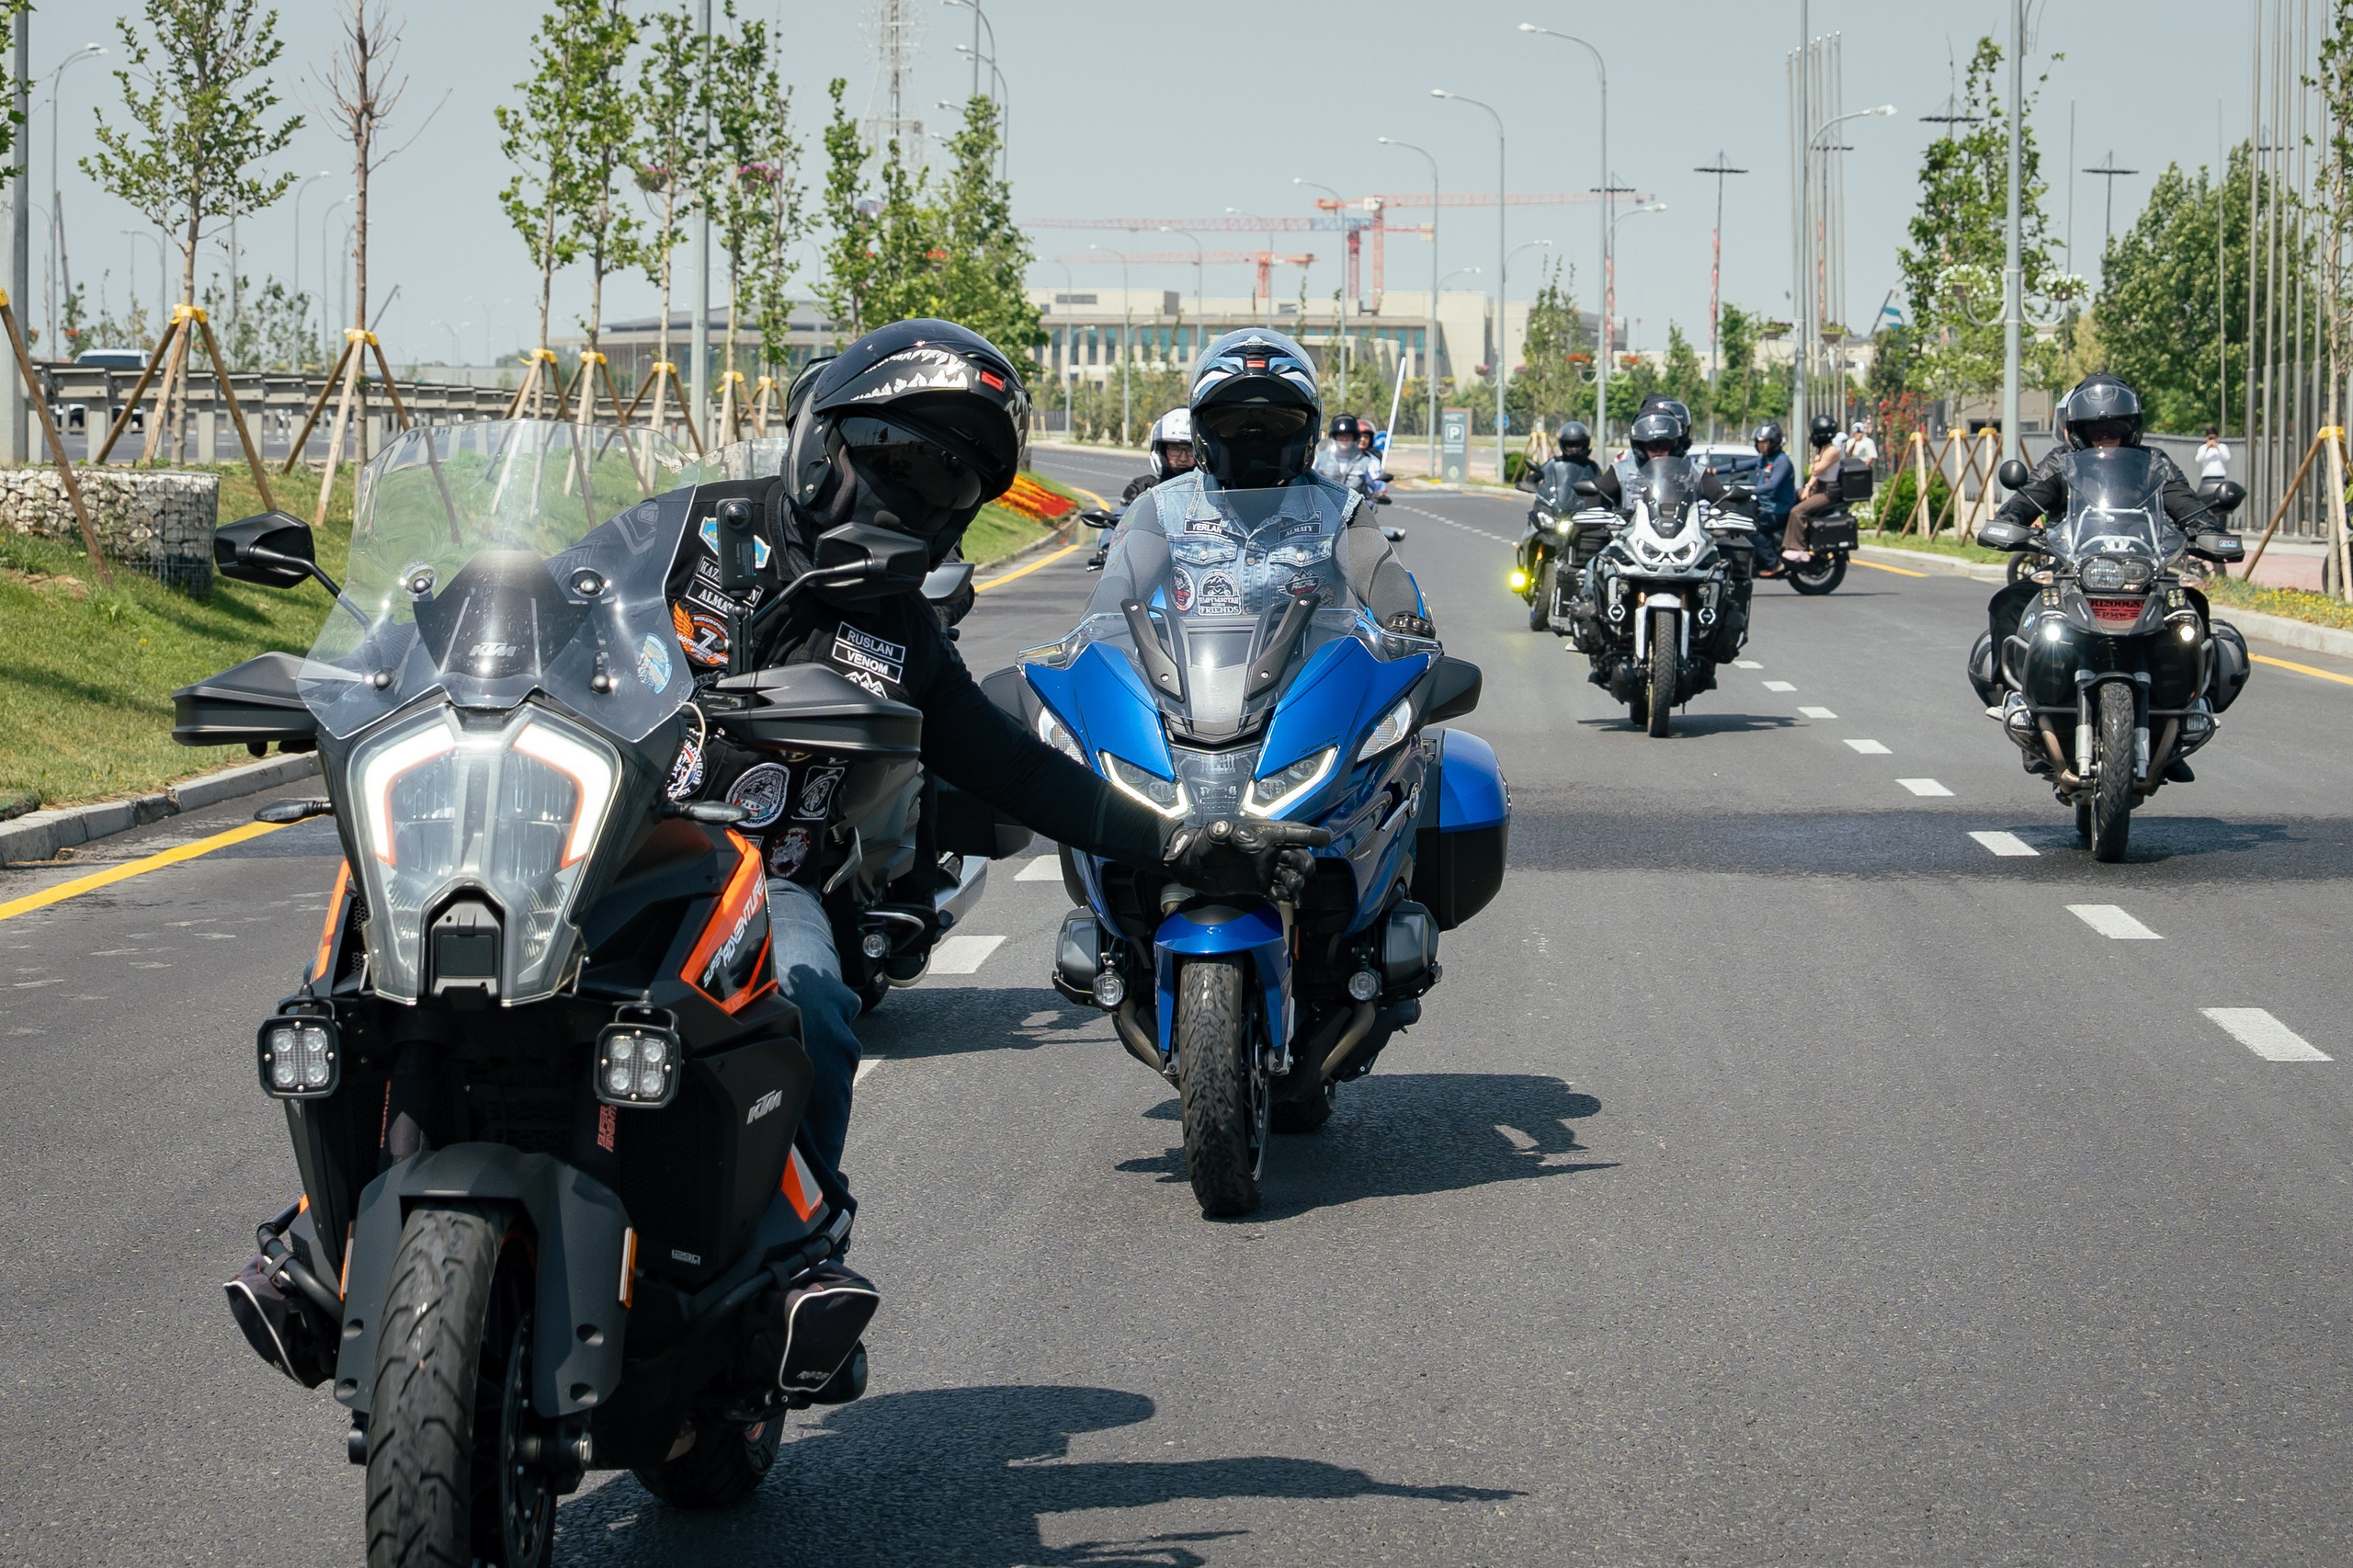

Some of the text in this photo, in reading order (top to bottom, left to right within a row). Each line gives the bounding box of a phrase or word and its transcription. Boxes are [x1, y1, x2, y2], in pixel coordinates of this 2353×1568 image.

[1449, 426, 1461, 439] P
[1192, 523, 1222, 534] YERLAN
[1285, 525, 1313, 537] ALMATY
[698, 589, 734, 614] ALMAT
[1200, 606, 1239, 614] FRIENDS
[700, 627, 718, 647] 7
[847, 630, 893, 656] RUSLAN
[469, 642, 517, 656] KTM
[847, 649, 889, 675] VENOM
[703, 871, 765, 988] SUPER ADVENTURE
[746, 1090, 782, 1125] KTM
